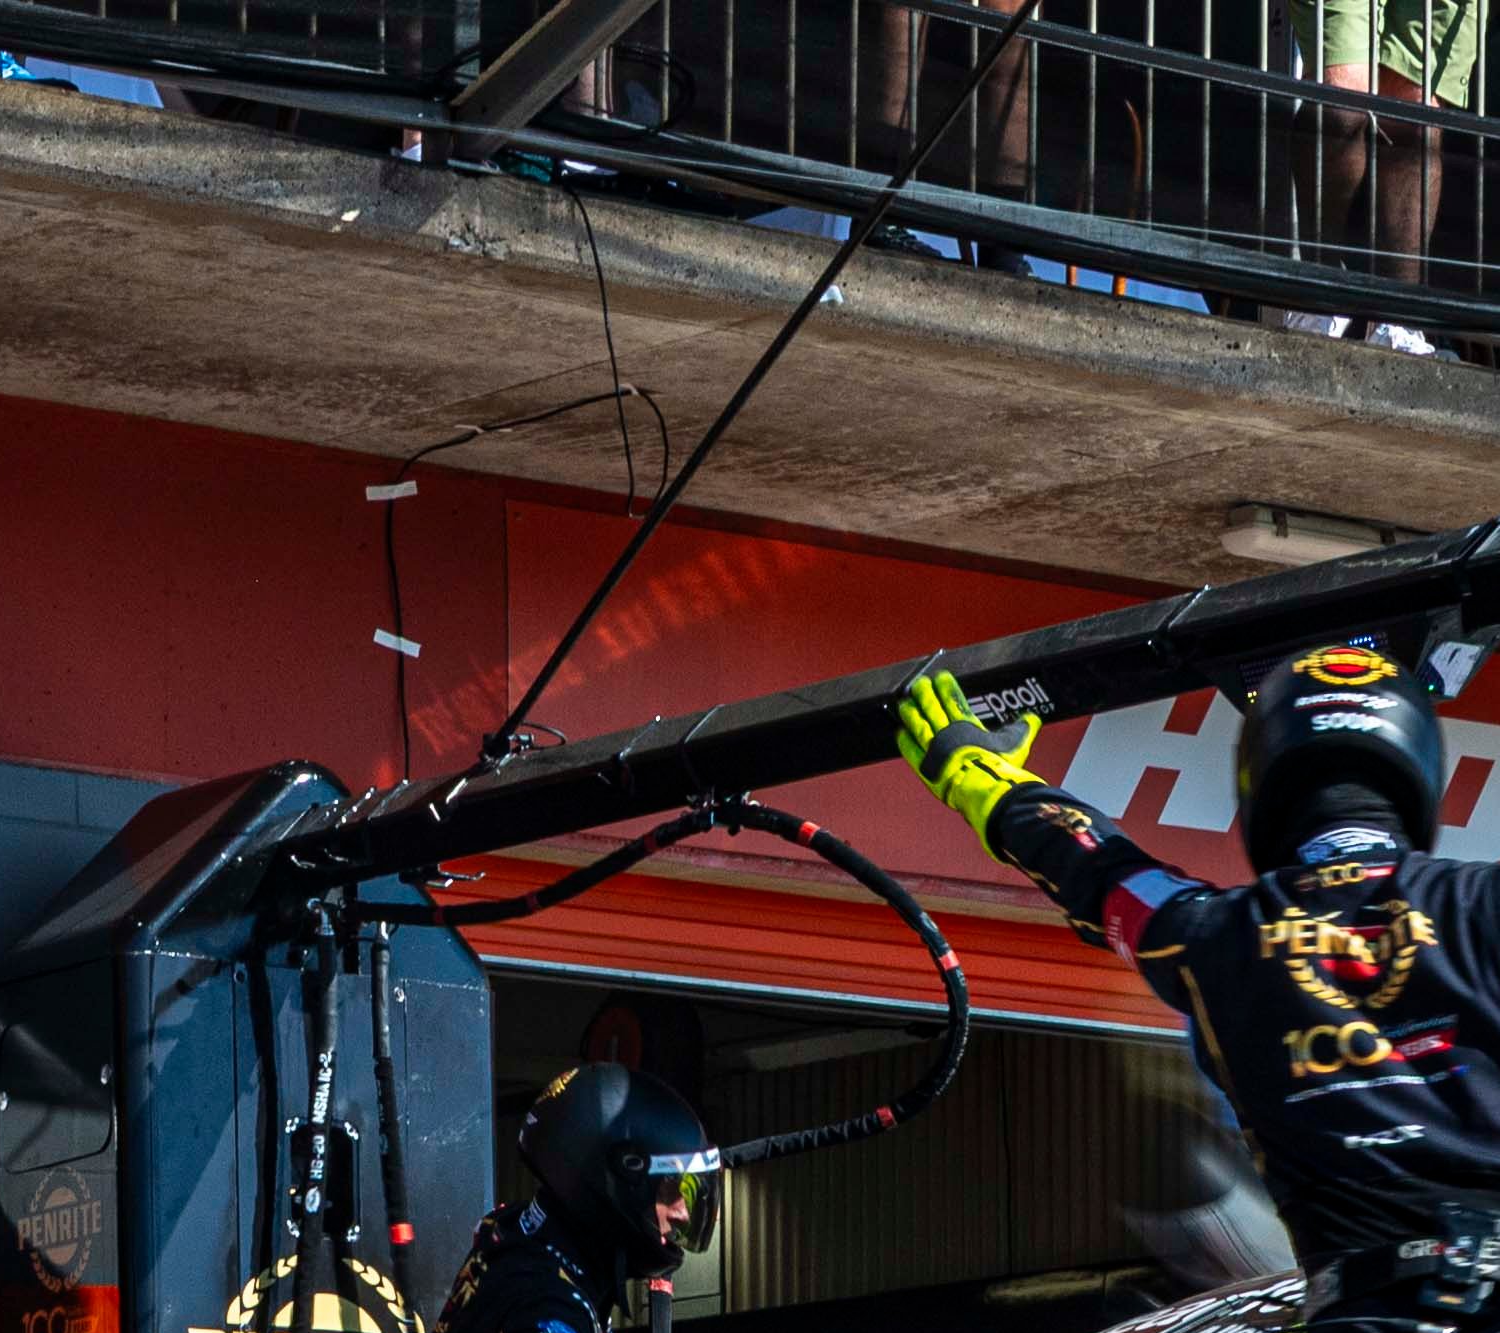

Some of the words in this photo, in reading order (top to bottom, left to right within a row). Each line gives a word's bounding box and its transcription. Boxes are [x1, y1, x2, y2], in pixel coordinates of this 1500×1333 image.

[986, 677, 1050, 723] paoli
[310, 1134, 326, 1180] HG-20
[17, 1202, 103, 1250] PENRITE
